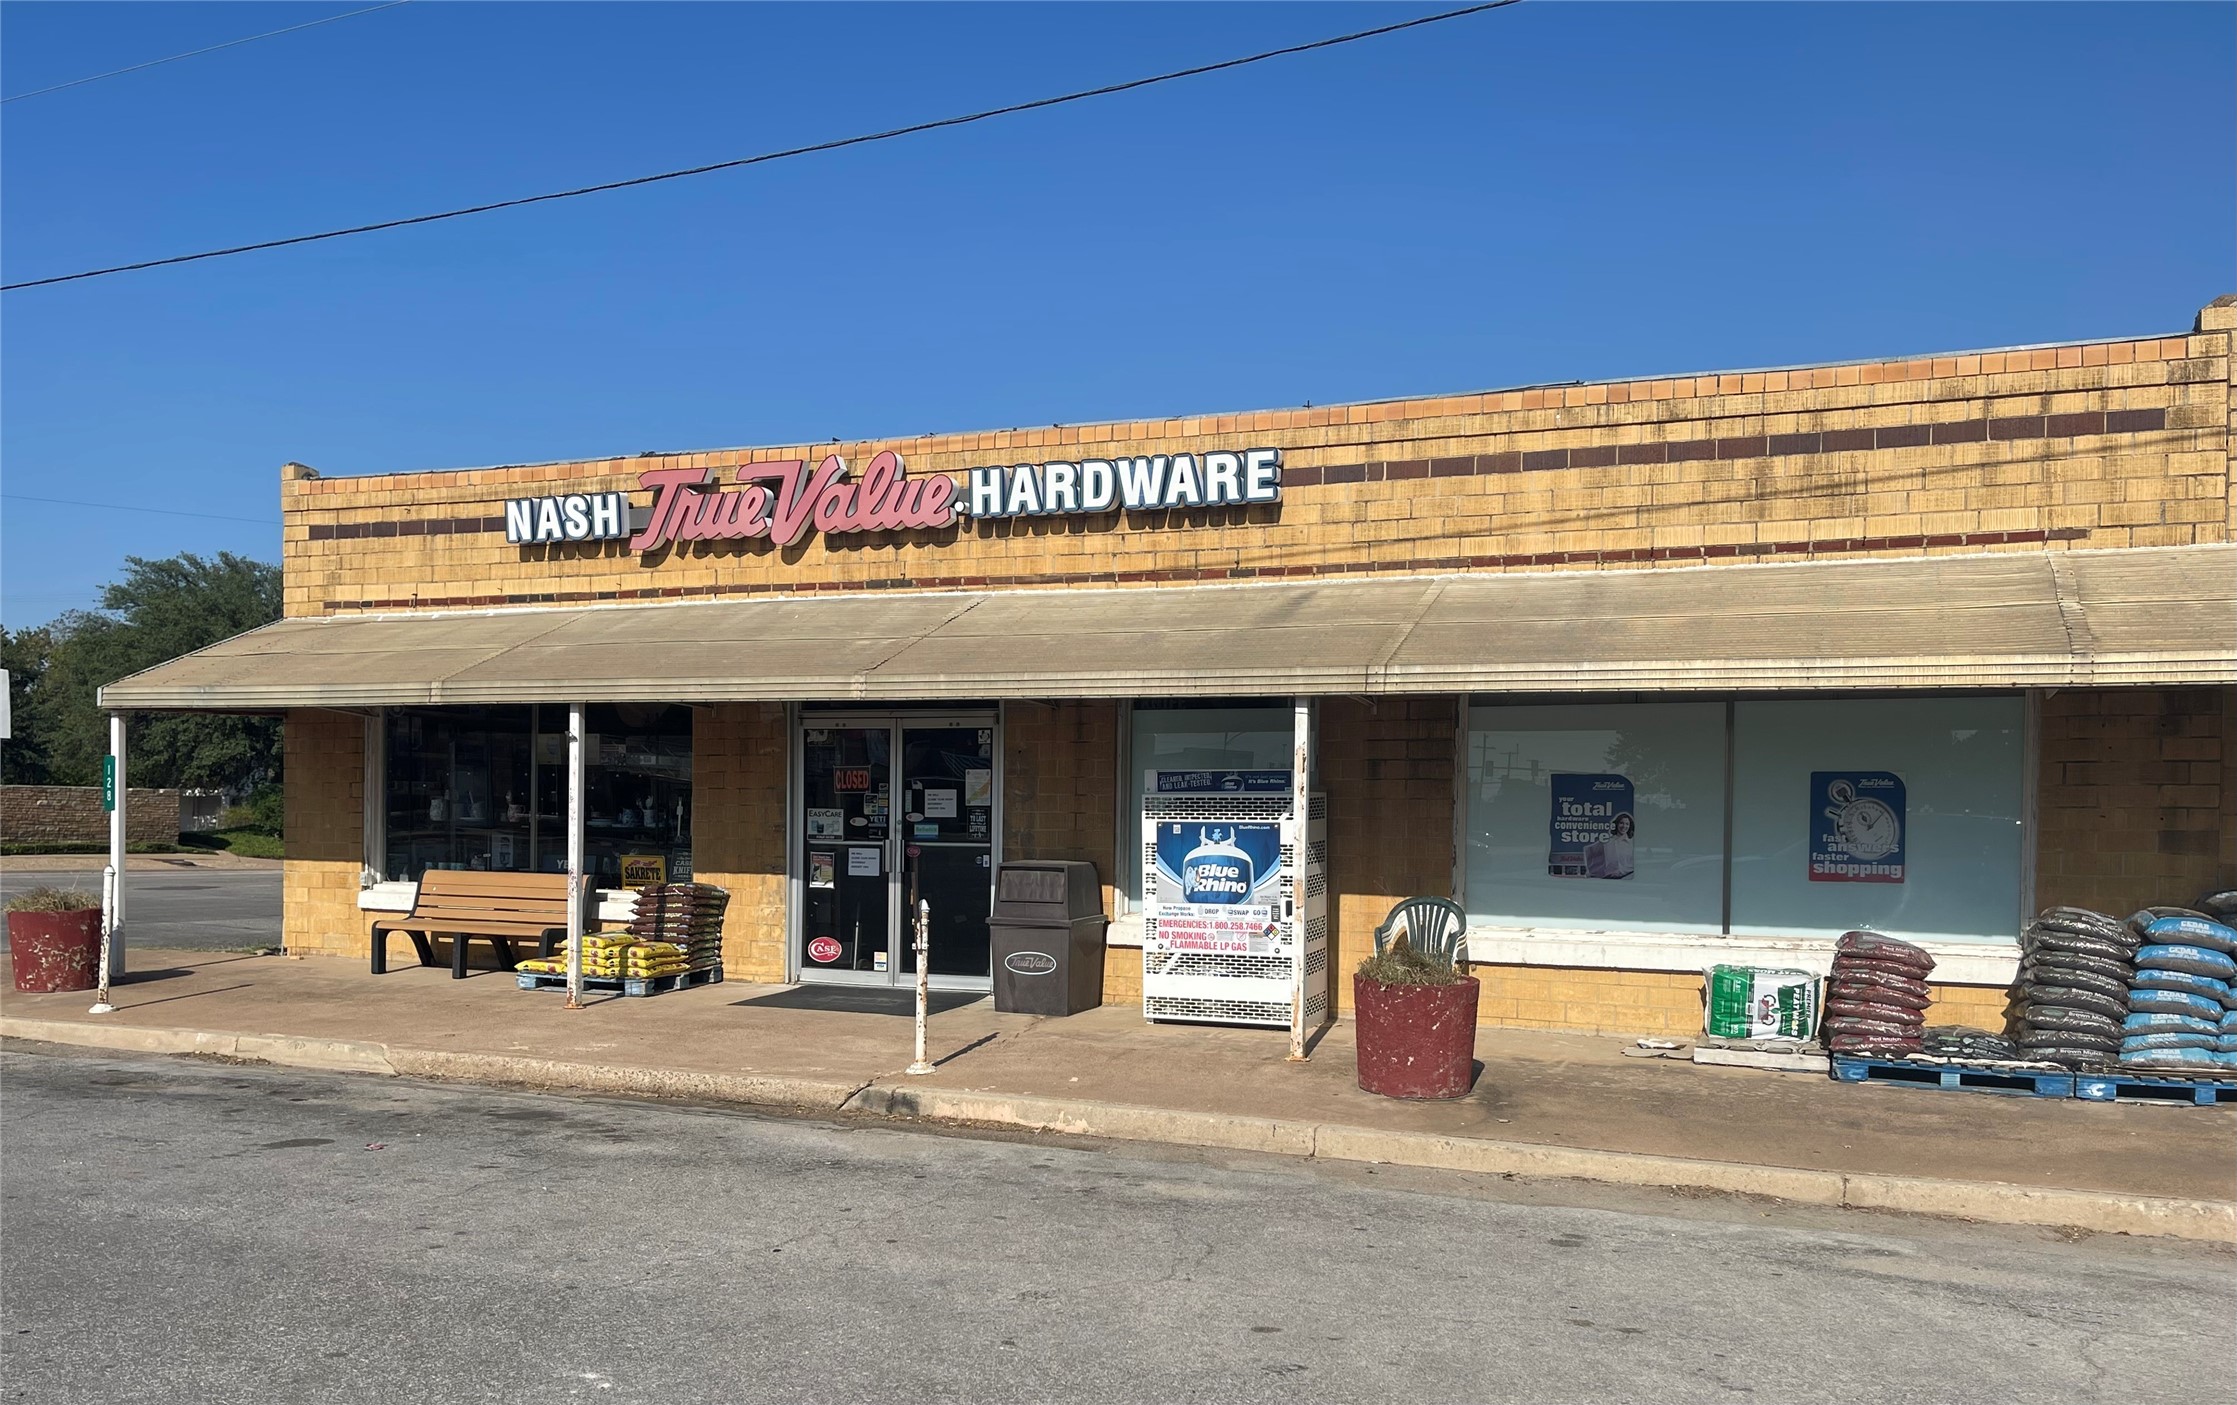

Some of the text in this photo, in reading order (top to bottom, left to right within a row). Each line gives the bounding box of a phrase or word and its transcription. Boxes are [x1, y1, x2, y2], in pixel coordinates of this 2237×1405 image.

[504, 492, 630, 544] NASH
[968, 447, 1283, 518] HARDWARE
[835, 770, 869, 789] CLOSED
[1562, 802, 1612, 816] total
[1555, 821, 1616, 830] convenience
[1561, 830, 1609, 843] store
[1822, 834, 1847, 842] fast
[1828, 842, 1899, 853] answers
[1812, 852, 1849, 861] faster
[557, 860, 568, 869] YE
[1813, 861, 1902, 878] shopping
[625, 867, 661, 880] SAKRETE
[1198, 864, 1239, 878] Blue
[1194, 878, 1246, 893] Rhino
[2181, 921, 2210, 930] CEDAR
[1159, 931, 1206, 940] NO SMOKING
[811, 942, 838, 956] CASE
[1170, 940, 1247, 951] FLAMMABLE LP GAS
[2169, 947, 2198, 956] CEDAR
[2101, 957, 2120, 966] Mulch
[2076, 970, 2118, 986] Brown Mulch
[2092, 1015, 2112, 1024] Mulch
